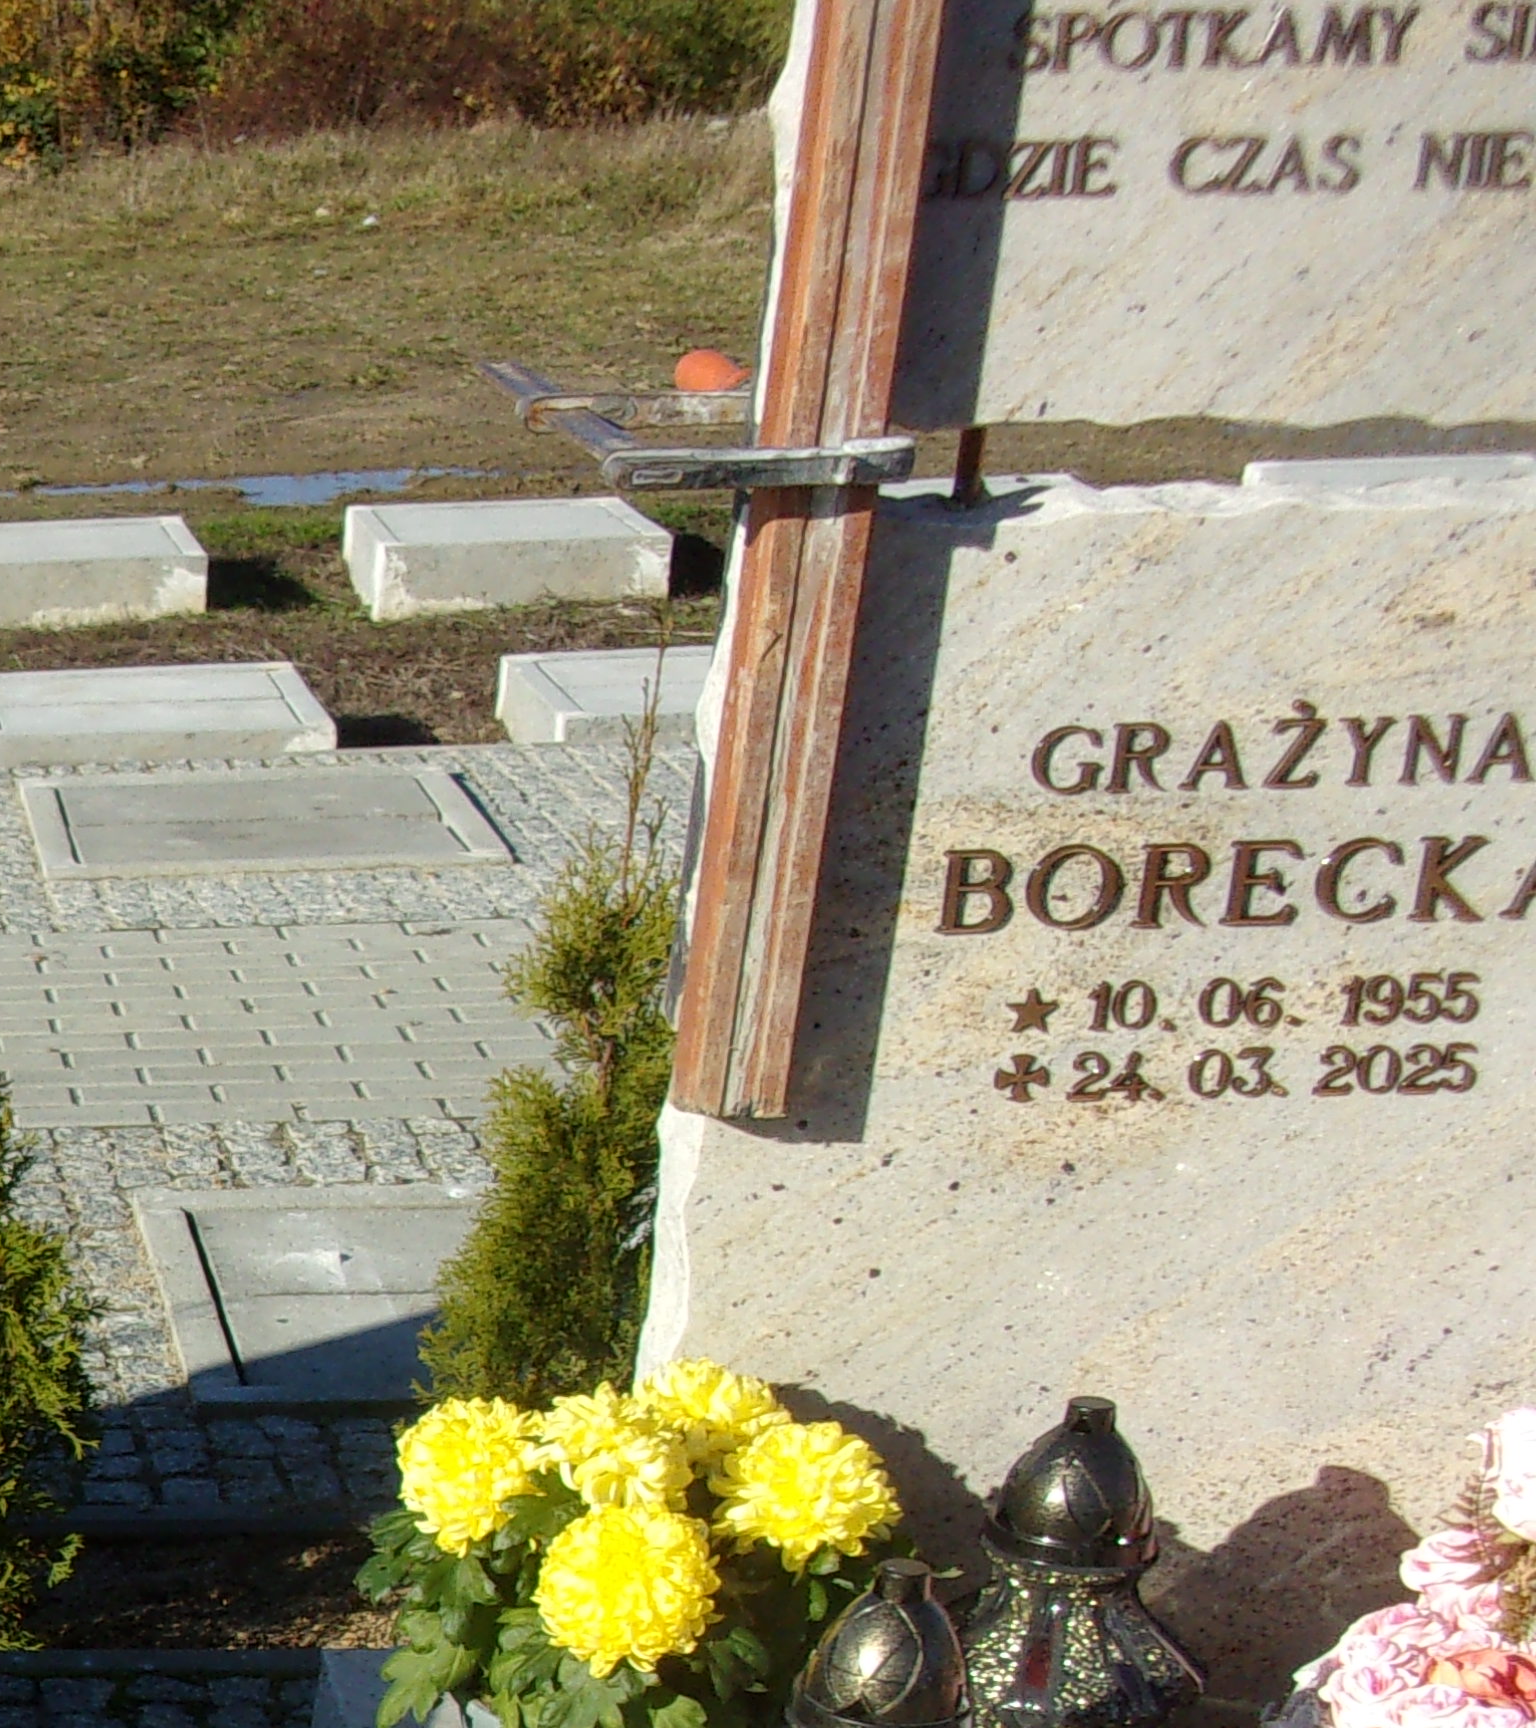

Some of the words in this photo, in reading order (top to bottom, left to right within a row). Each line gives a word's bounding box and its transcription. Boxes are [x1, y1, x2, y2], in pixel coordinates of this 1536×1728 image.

[1007, 3, 1419, 73] SPOTKAMY
[1464, 0, 1536, 65] SI
[1169, 131, 1360, 196] CZAS
[1412, 128, 1536, 193] NIE
[1031, 699, 1535, 796] GRAŻYNA
[1087, 979, 1177, 1032] 10.
[1198, 977, 1307, 1029] 06.
[1339, 971, 1482, 1027] 1955
[1066, 1050, 1166, 1101] 24.
[1187, 1046, 1290, 1099] 03.
[1311, 1042, 1480, 1097] 2025
